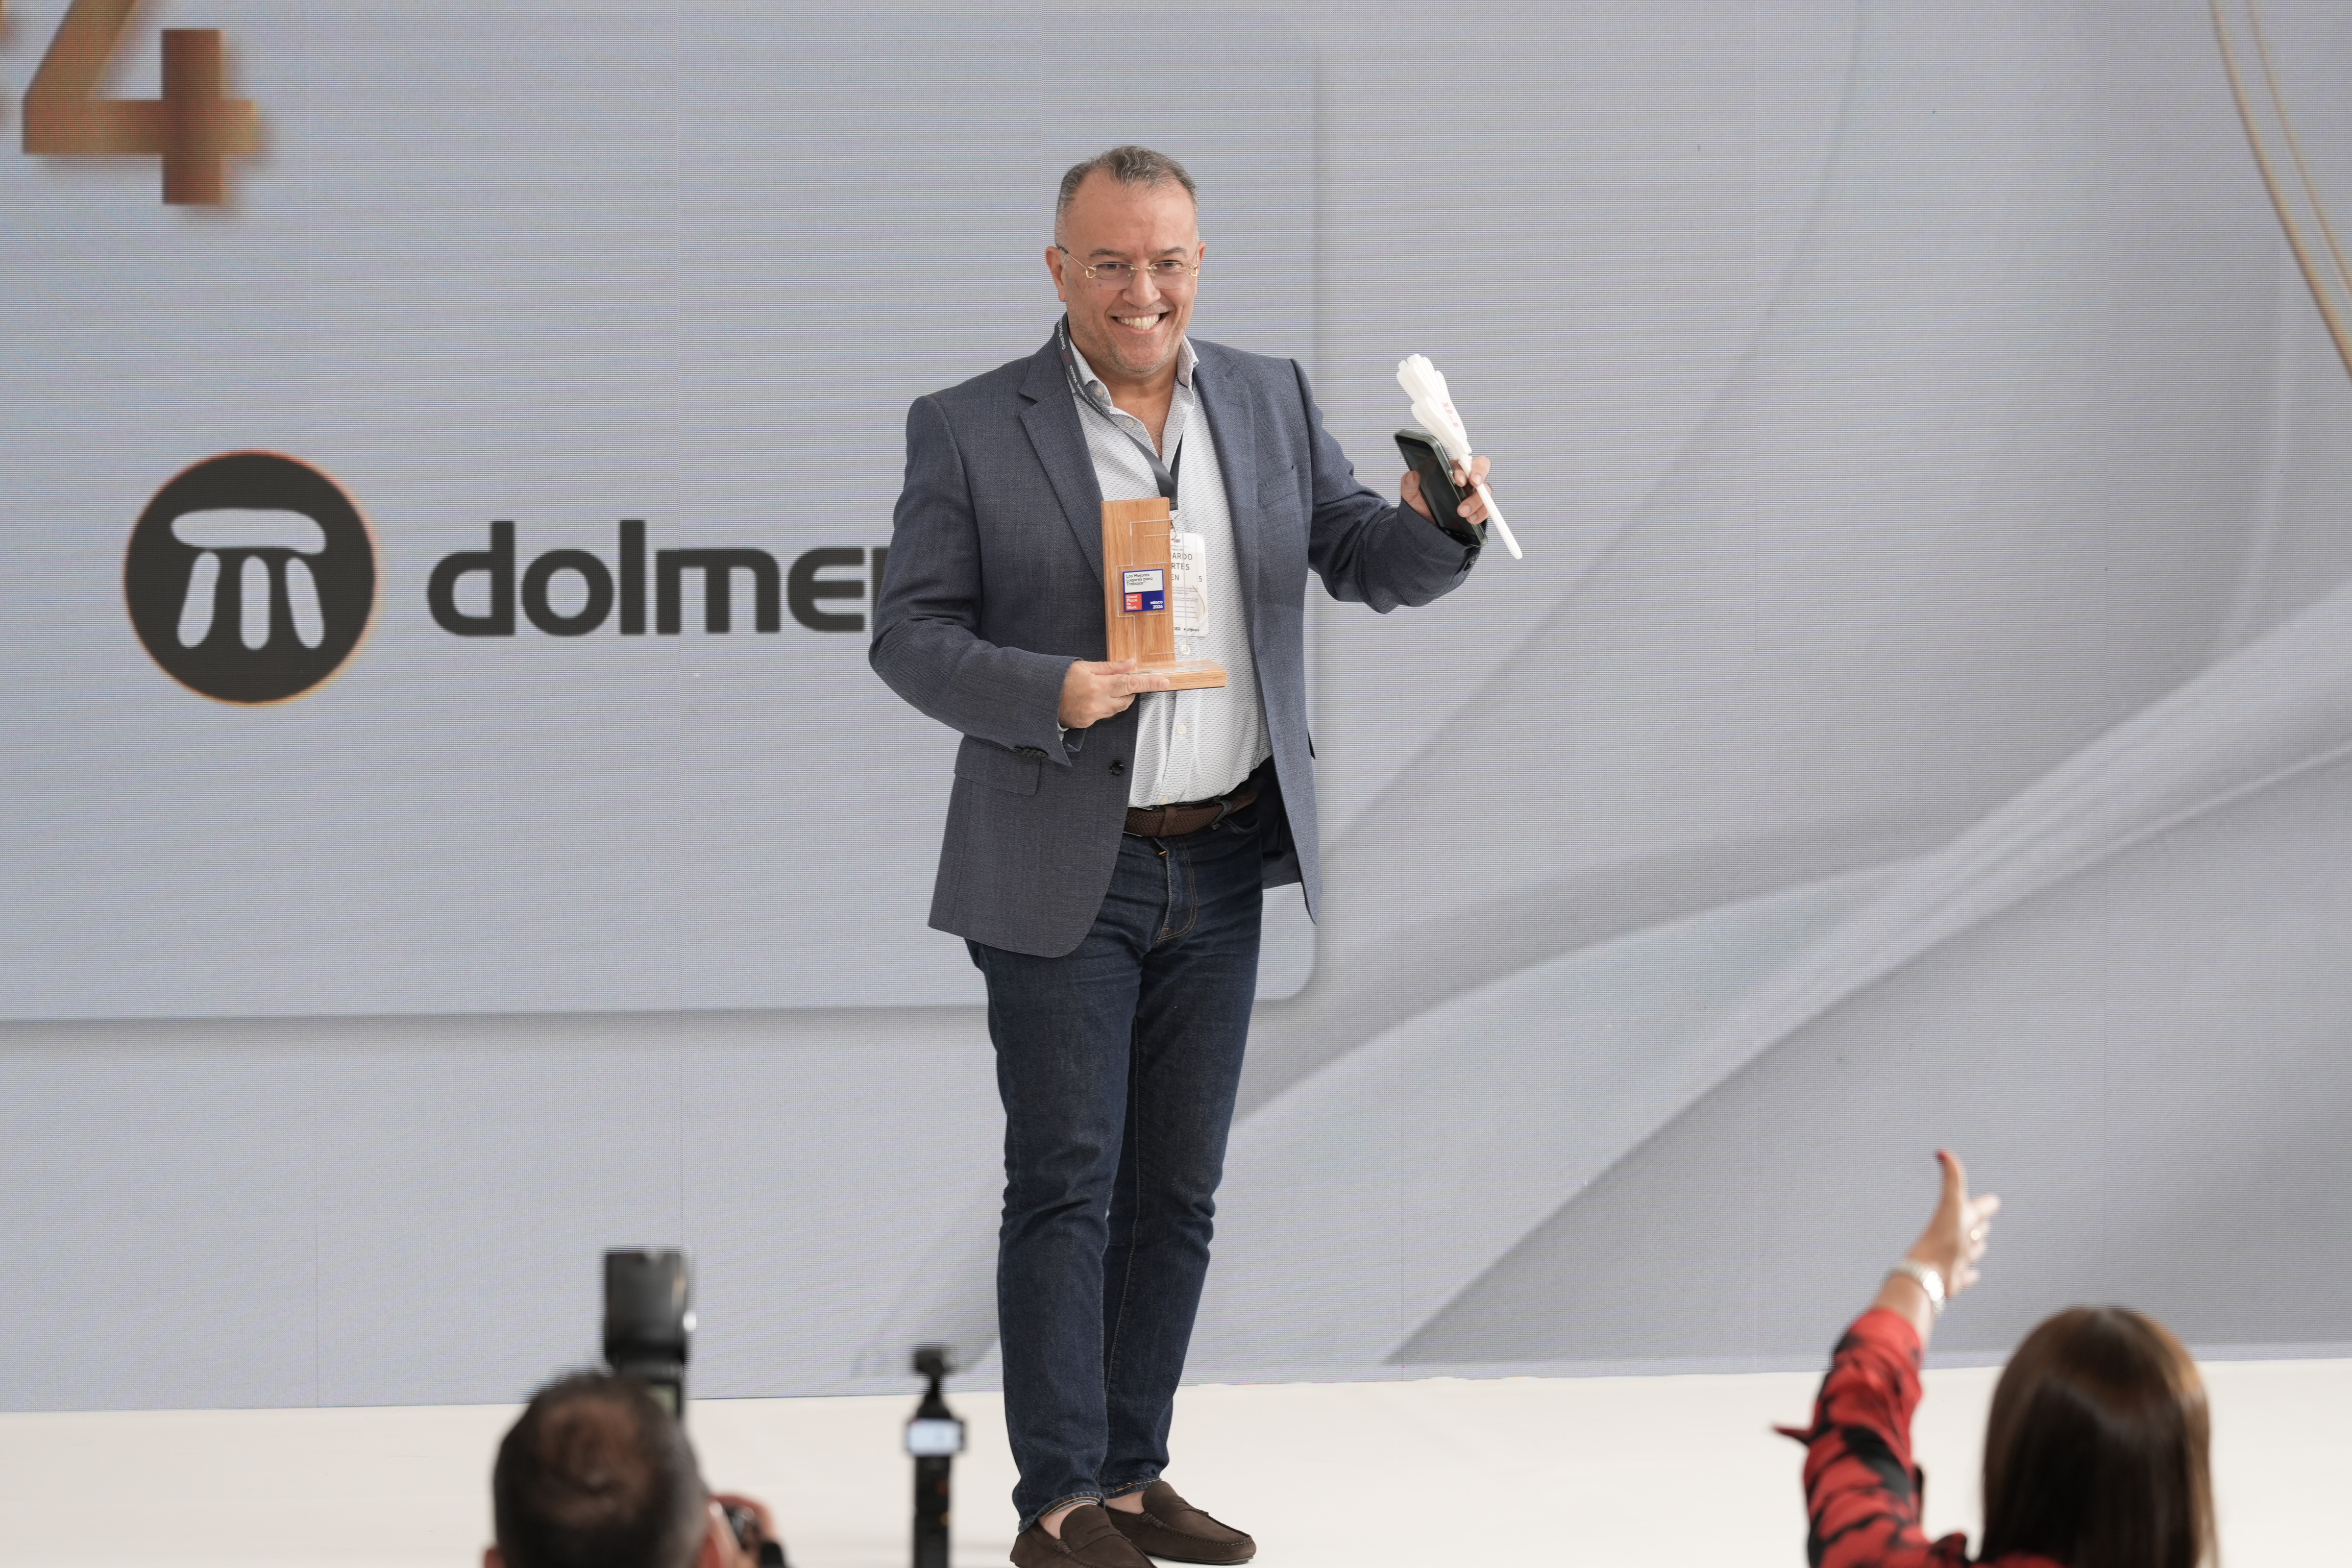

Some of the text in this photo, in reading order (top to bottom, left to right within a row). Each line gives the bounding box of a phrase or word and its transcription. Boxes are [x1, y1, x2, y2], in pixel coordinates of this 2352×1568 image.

[21, 0, 261, 205] 4
[427, 519, 891, 638] dolme
[1171, 562, 1190, 571] RTES
[1172, 552, 1193, 560] ARDO
